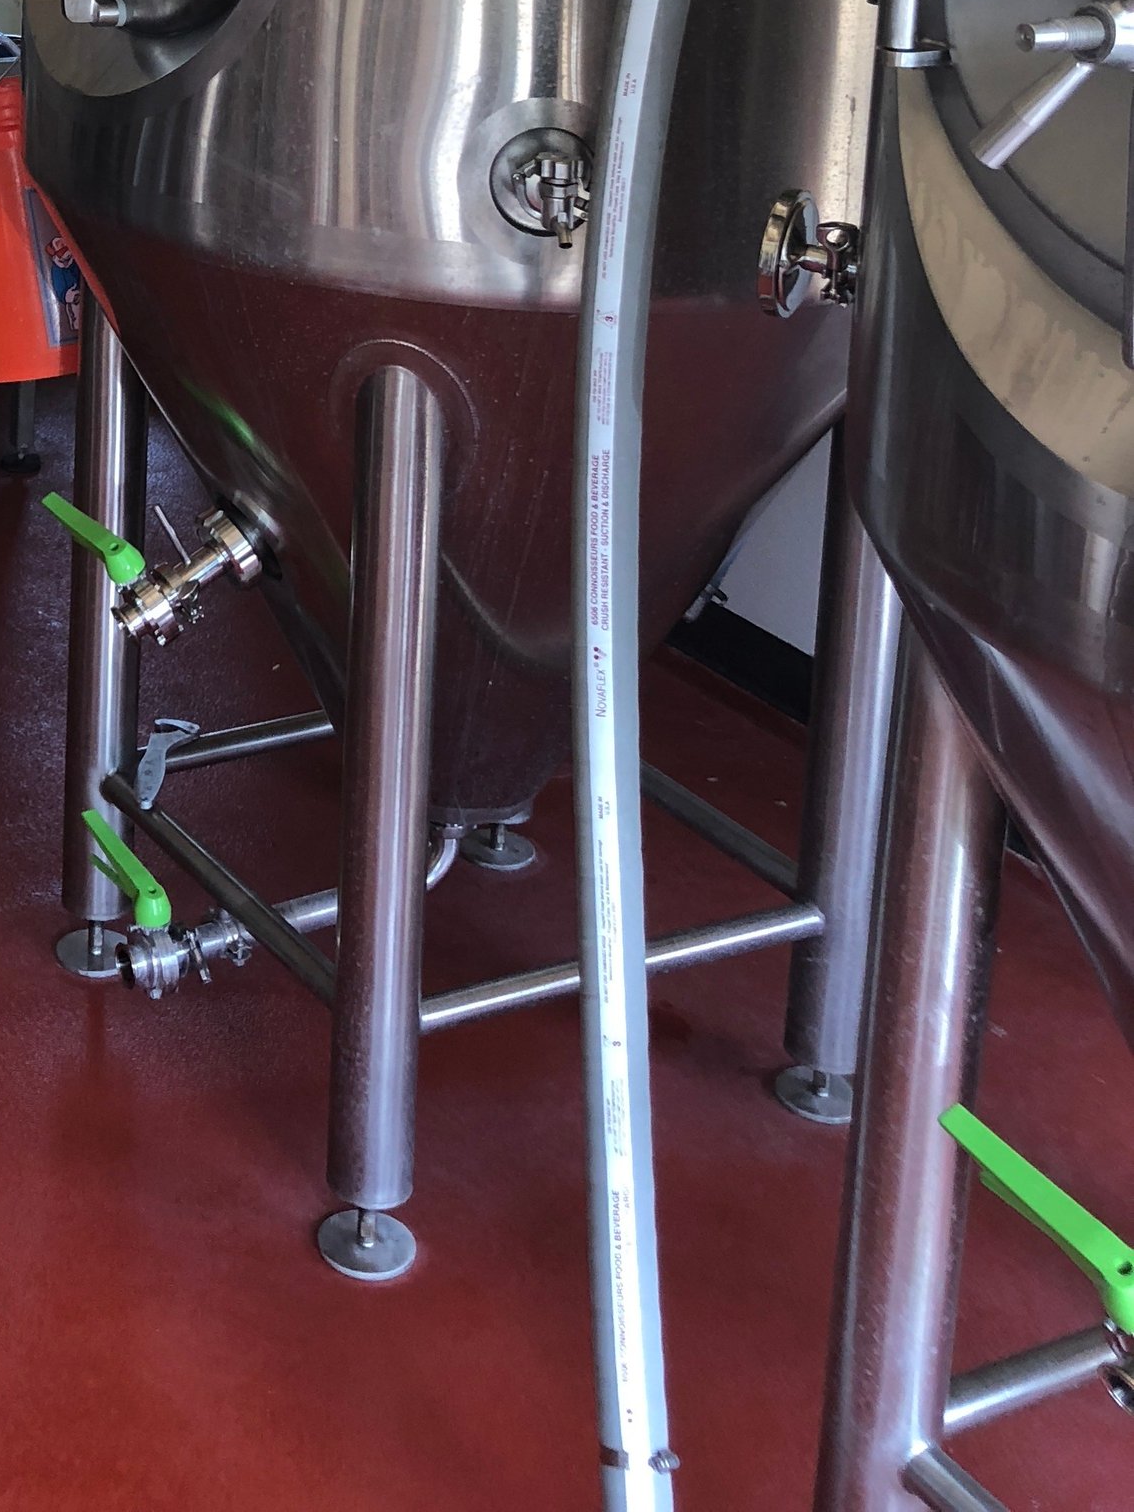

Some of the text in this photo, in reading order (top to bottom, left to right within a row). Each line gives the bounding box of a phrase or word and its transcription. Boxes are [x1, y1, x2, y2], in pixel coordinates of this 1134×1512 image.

[591, 455, 599, 501] BEVERAGE
[602, 449, 610, 498] DISCHARGE
[601, 514, 609, 546] SUCTION
[602, 504, 609, 512] &
[601, 553, 609, 599] RESISTANT
[601, 601, 609, 631] CRUSH
[612, 1190, 621, 1242] BEVERAGE
